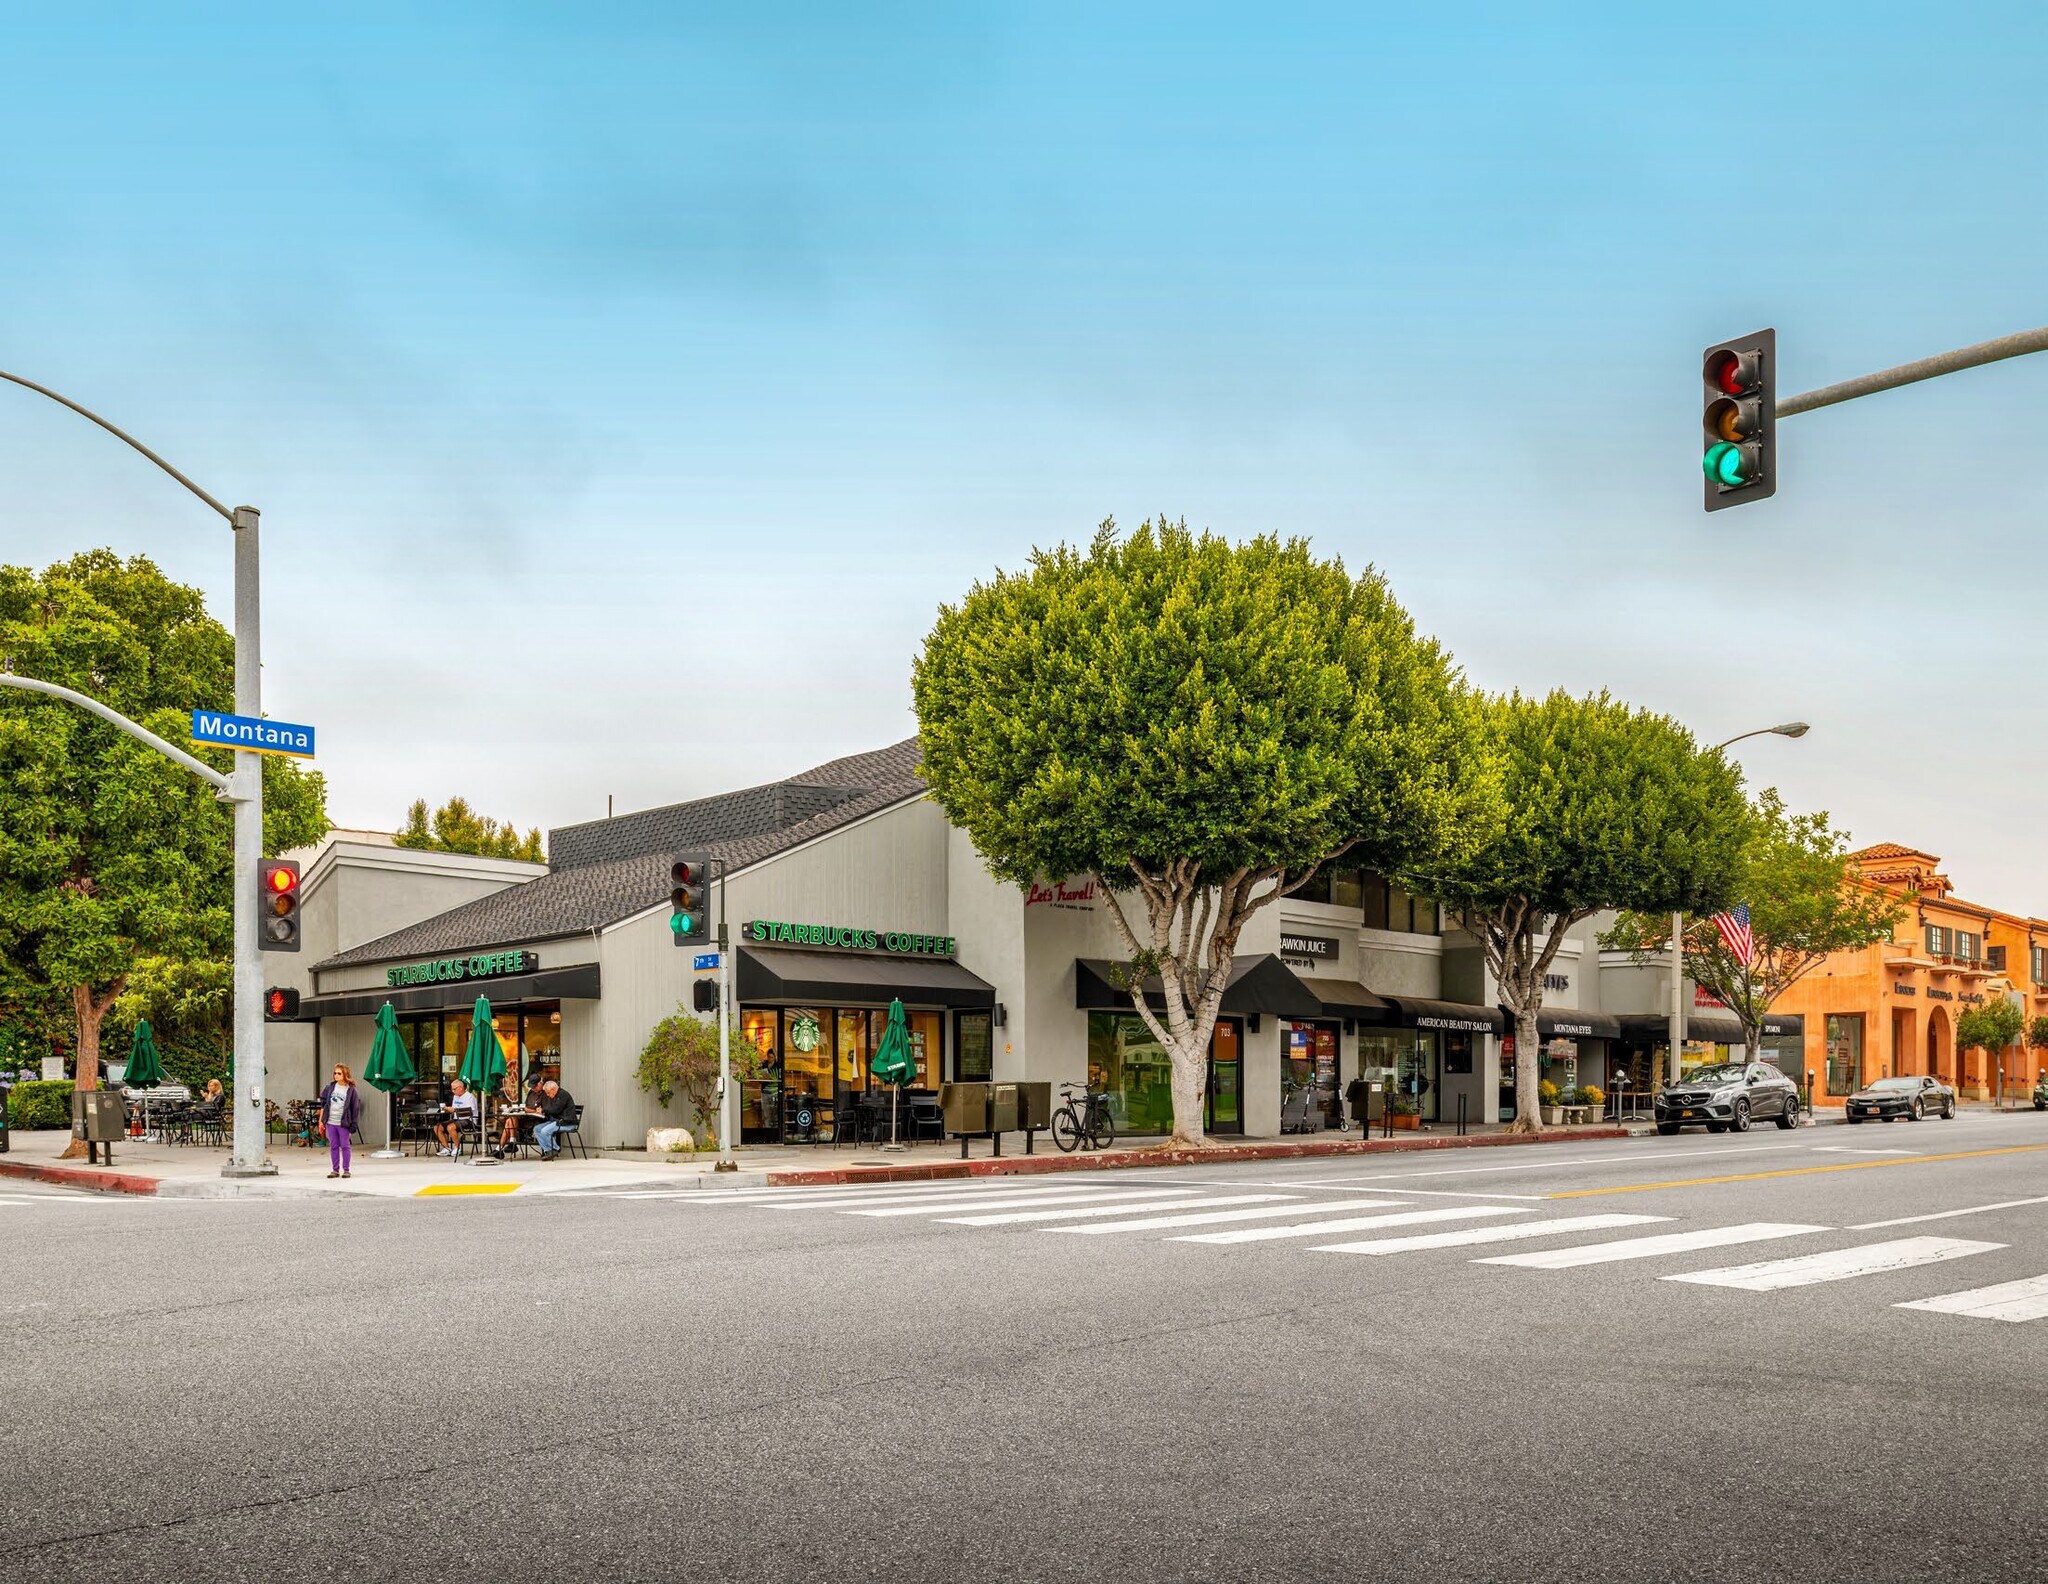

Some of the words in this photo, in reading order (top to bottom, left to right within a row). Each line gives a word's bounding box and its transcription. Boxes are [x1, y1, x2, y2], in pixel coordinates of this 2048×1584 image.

[199, 715, 309, 748] Montana
[1026, 883, 1053, 906] Let's
[1054, 881, 1094, 902] Travel!
[753, 920, 877, 949] STARBUCKS
[885, 932, 956, 954] COFFEE
[1307, 940, 1327, 954] JUICE
[387, 959, 464, 987] STARBUCKS
[468, 951, 524, 976] COFFEE
[1220, 1027, 1231, 1037] 703
[1417, 1017, 1449, 1028] AMERICAN
[1448, 1019, 1473, 1030] BEAUTY
[1472, 1021, 1492, 1031] SALON
[1553, 1024, 1580, 1034] MONTANA
[1579, 1026, 1592, 1035] EYES
